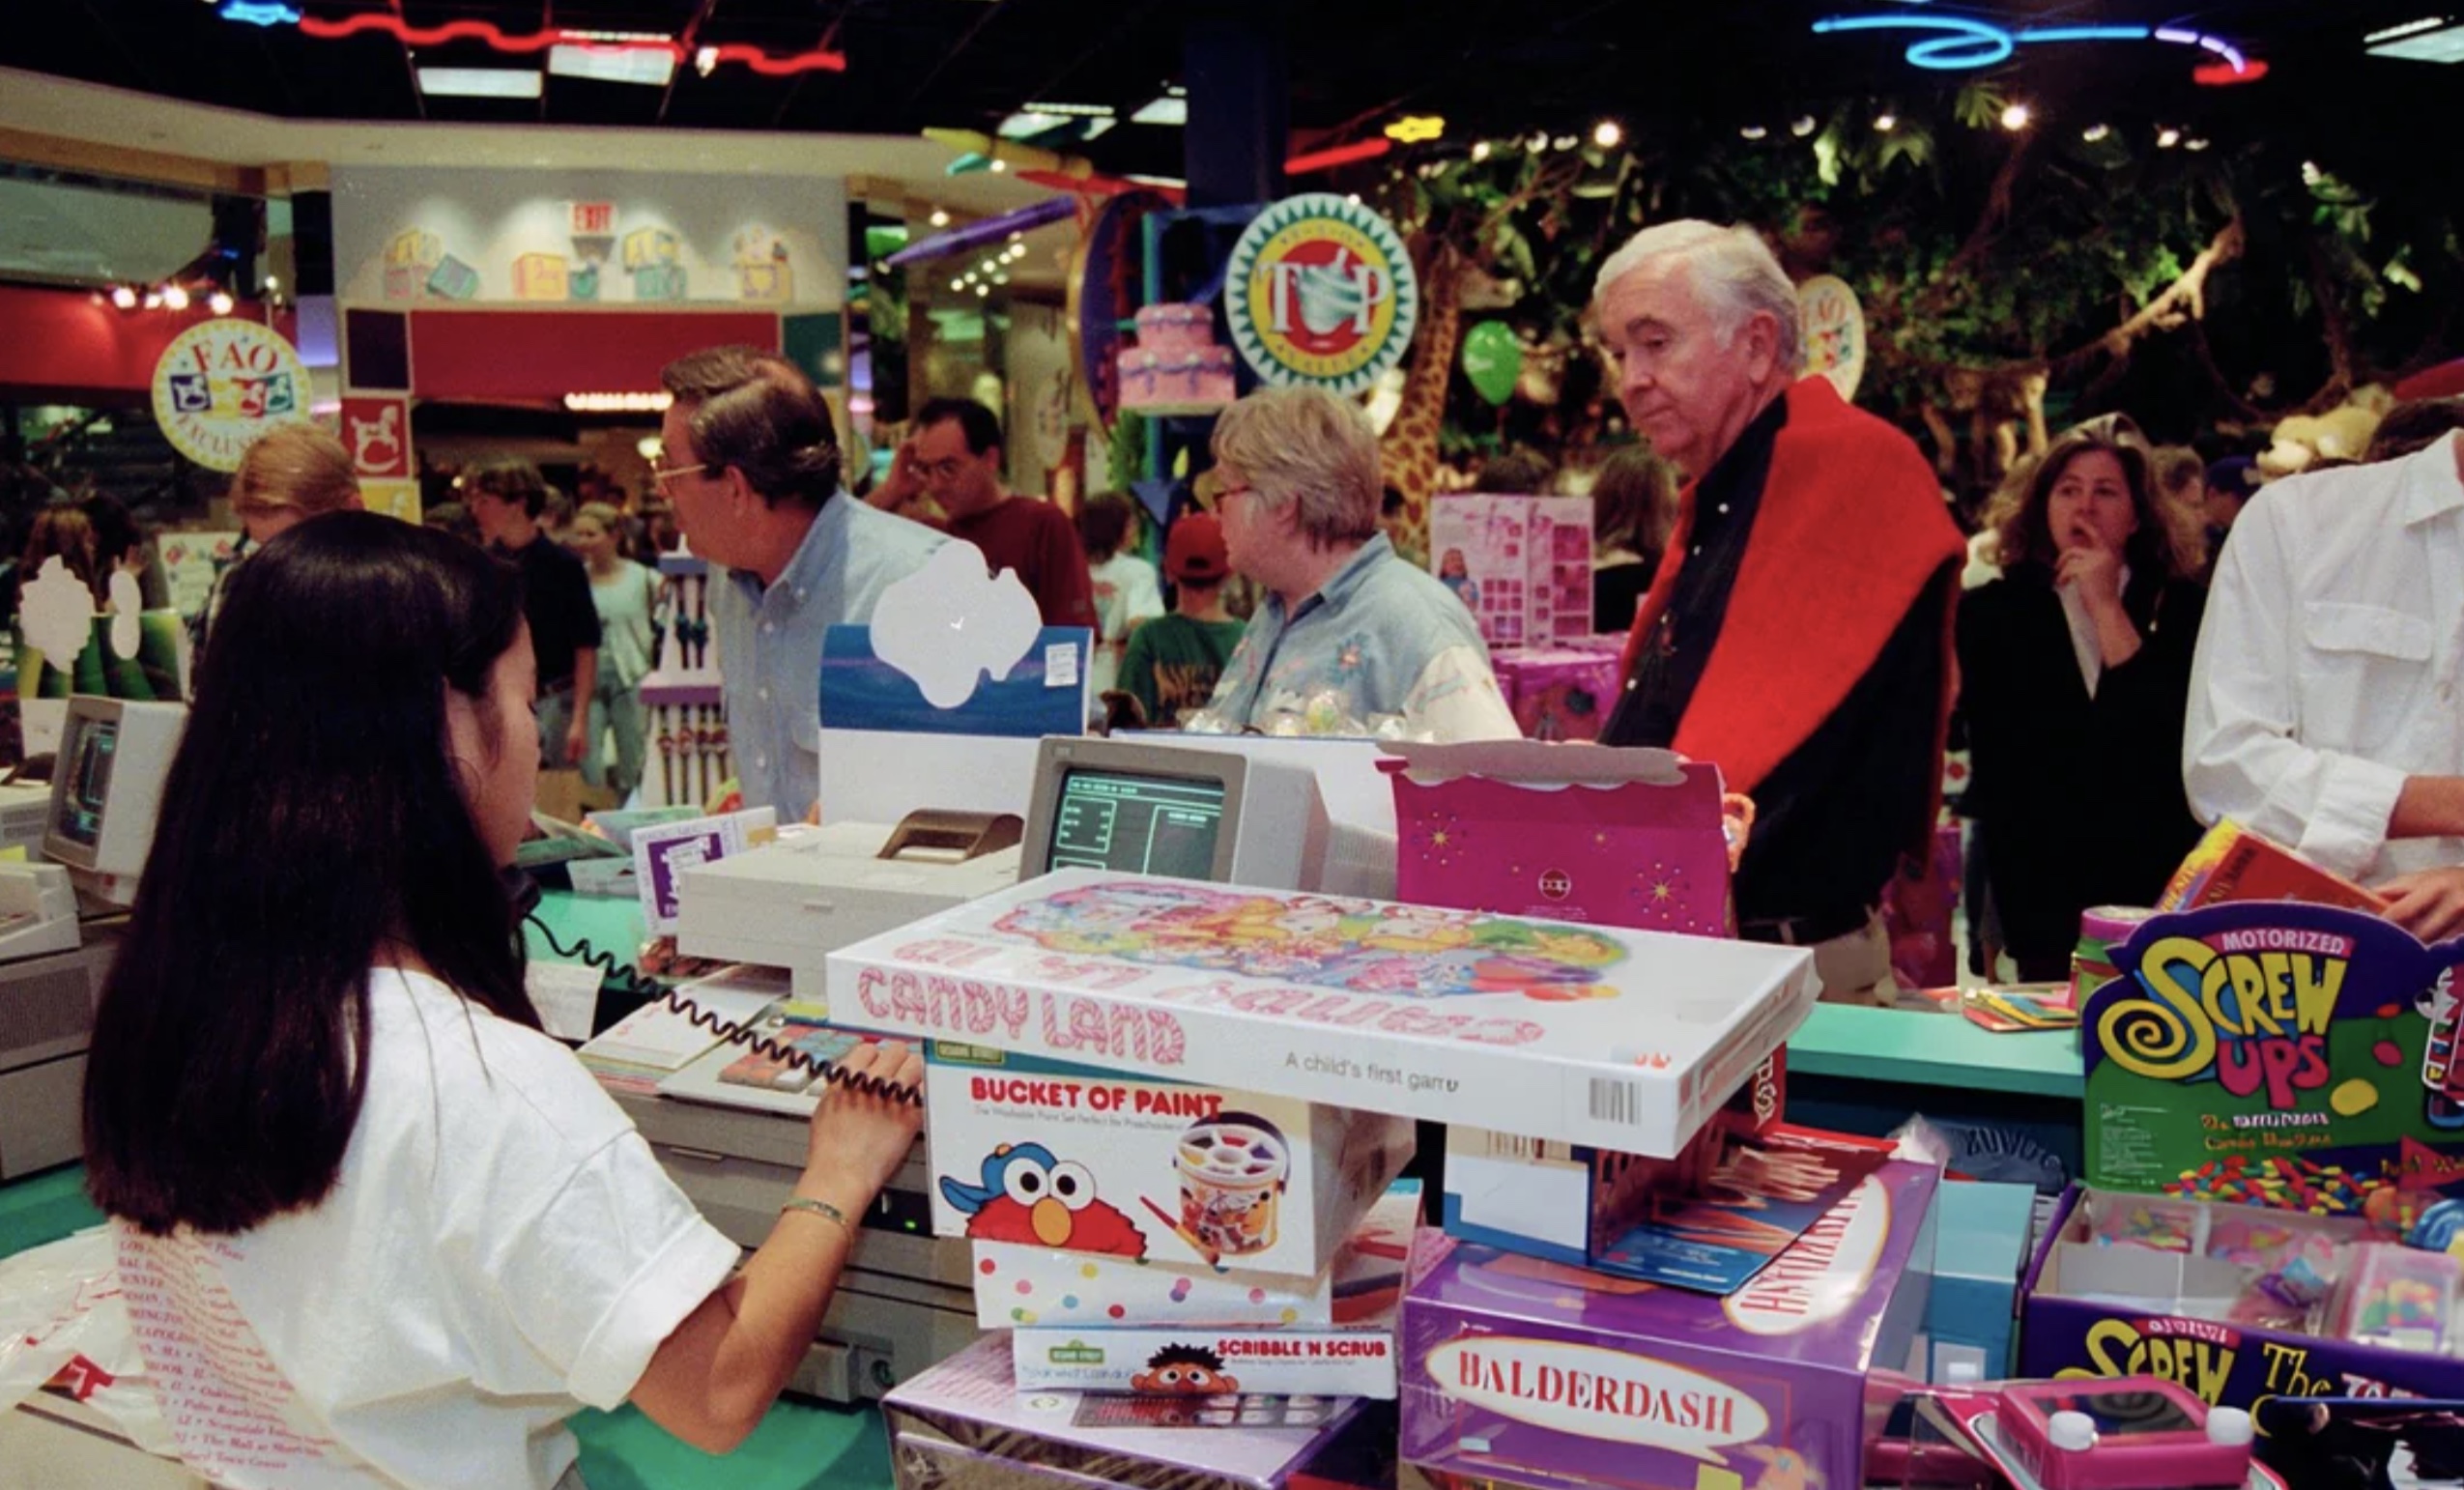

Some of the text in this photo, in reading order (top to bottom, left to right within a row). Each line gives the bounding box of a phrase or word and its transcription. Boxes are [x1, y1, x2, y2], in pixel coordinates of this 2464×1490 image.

[191, 339, 278, 373] FAO
[2222, 929, 2345, 955] MOTORIZED
[857, 967, 1029, 1040] CANDY
[1041, 991, 1186, 1065] LAND
[2098, 935, 2349, 1079] SCREW
[1285, 1051, 1299, 1068] A
[1304, 1052, 1362, 1079] child's
[1367, 1063, 1404, 1086] first
[2218, 1035, 2331, 1110] UPS
[970, 1076, 1223, 1120] BUCKET OF PAINT
[1218, 1339, 1387, 1357] SCRIBBLE 'N SCRUB
[2262, 1341, 2334, 1398] The
[1459, 1349, 1735, 1436] BALDERDASH
